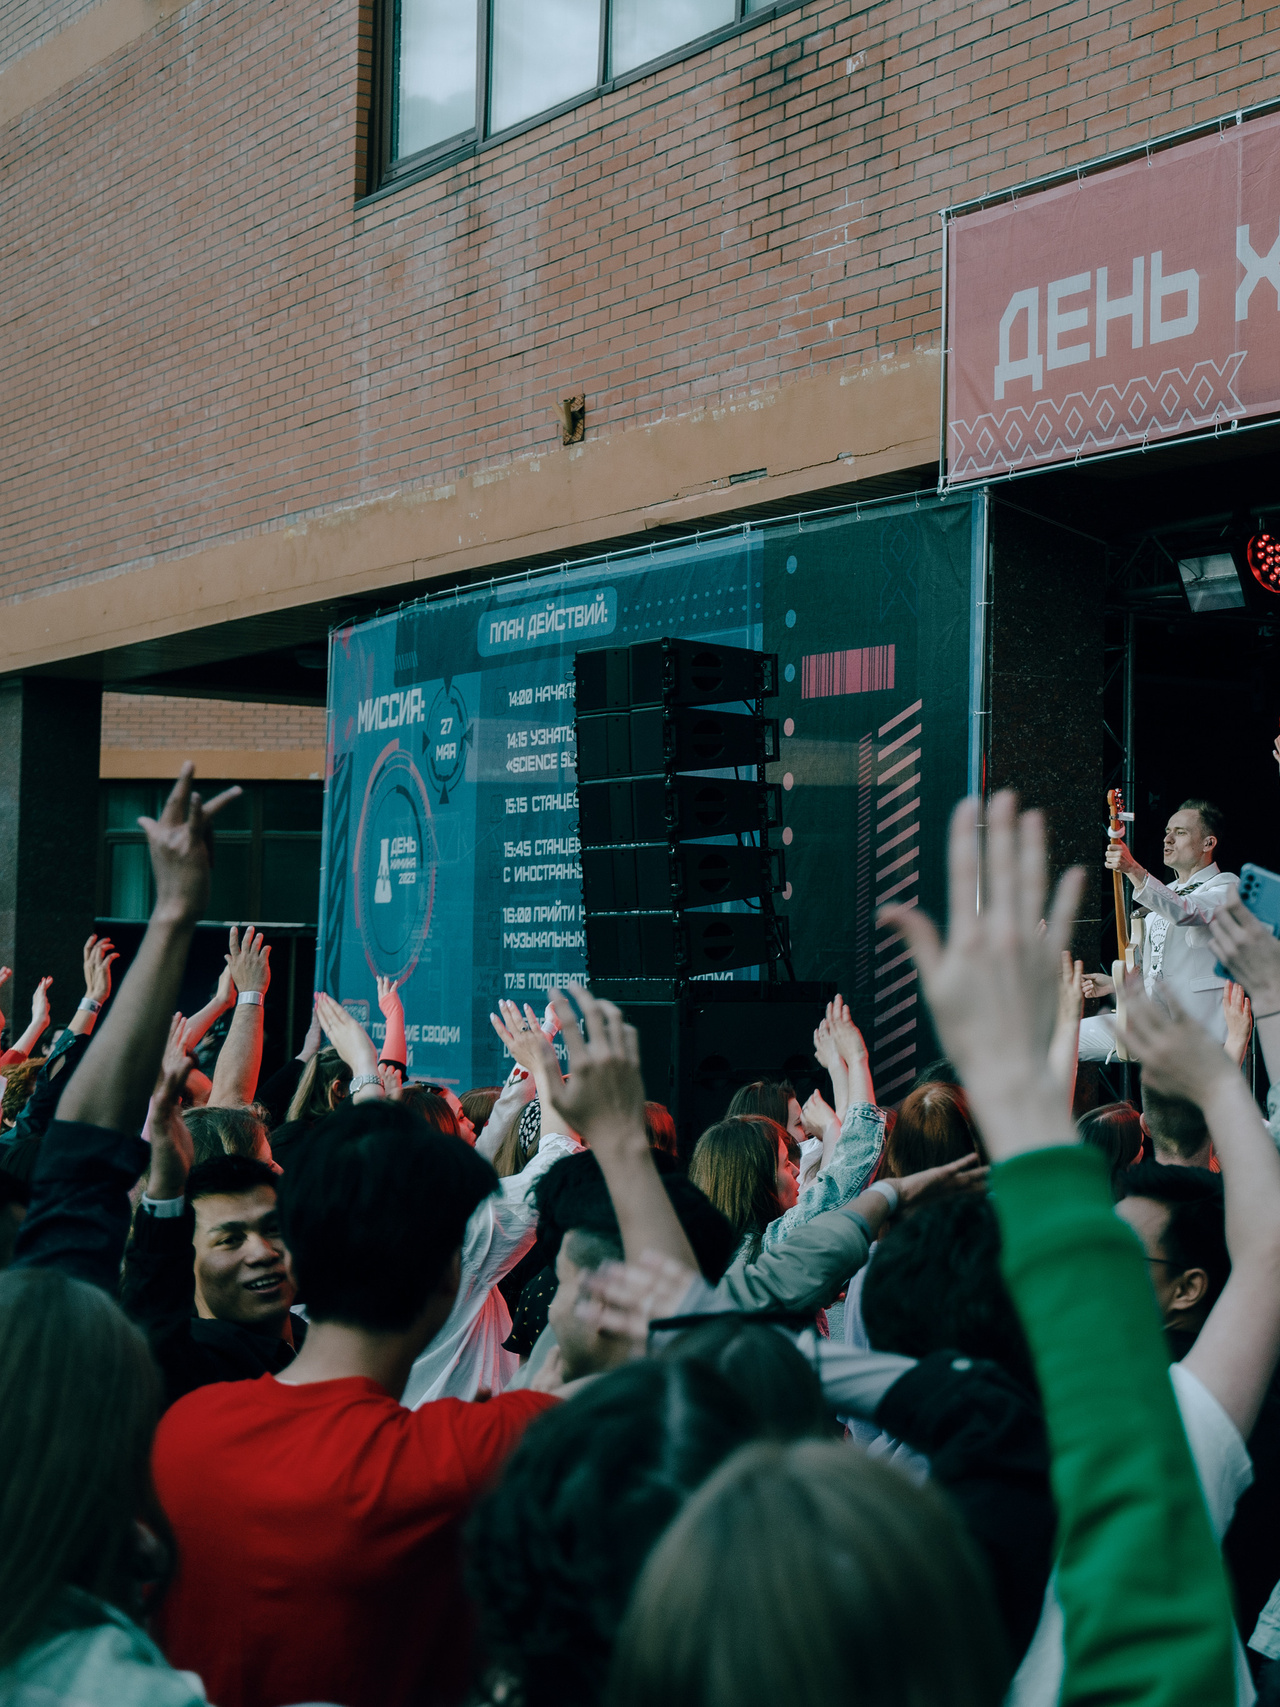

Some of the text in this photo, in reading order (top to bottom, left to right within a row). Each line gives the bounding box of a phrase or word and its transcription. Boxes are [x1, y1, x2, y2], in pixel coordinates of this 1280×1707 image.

[994, 250, 1199, 400] ДЕНЬ
[490, 593, 608, 644] ПЛАН ДЕЙСТВИЙ:
[508, 688, 533, 707] 14:00
[358, 688, 425, 734] МИССИЯ:
[440, 718, 453, 735] 27
[507, 731, 528, 749] 14:15
[436, 743, 456, 761] МАЯ
[505, 797, 528, 814] 15:15
[390, 836, 416, 857] ДЕНЬ
[504, 840, 531, 857] 15:45
[503, 907, 532, 923] 16:00
[534, 900, 575, 922] ПРИЙТИ
[504, 931, 585, 948] МУЗЫКАЛЬНЫХ
[504, 973, 525, 989] 17:15
[422, 1025, 460, 1045] СВОДКИ
